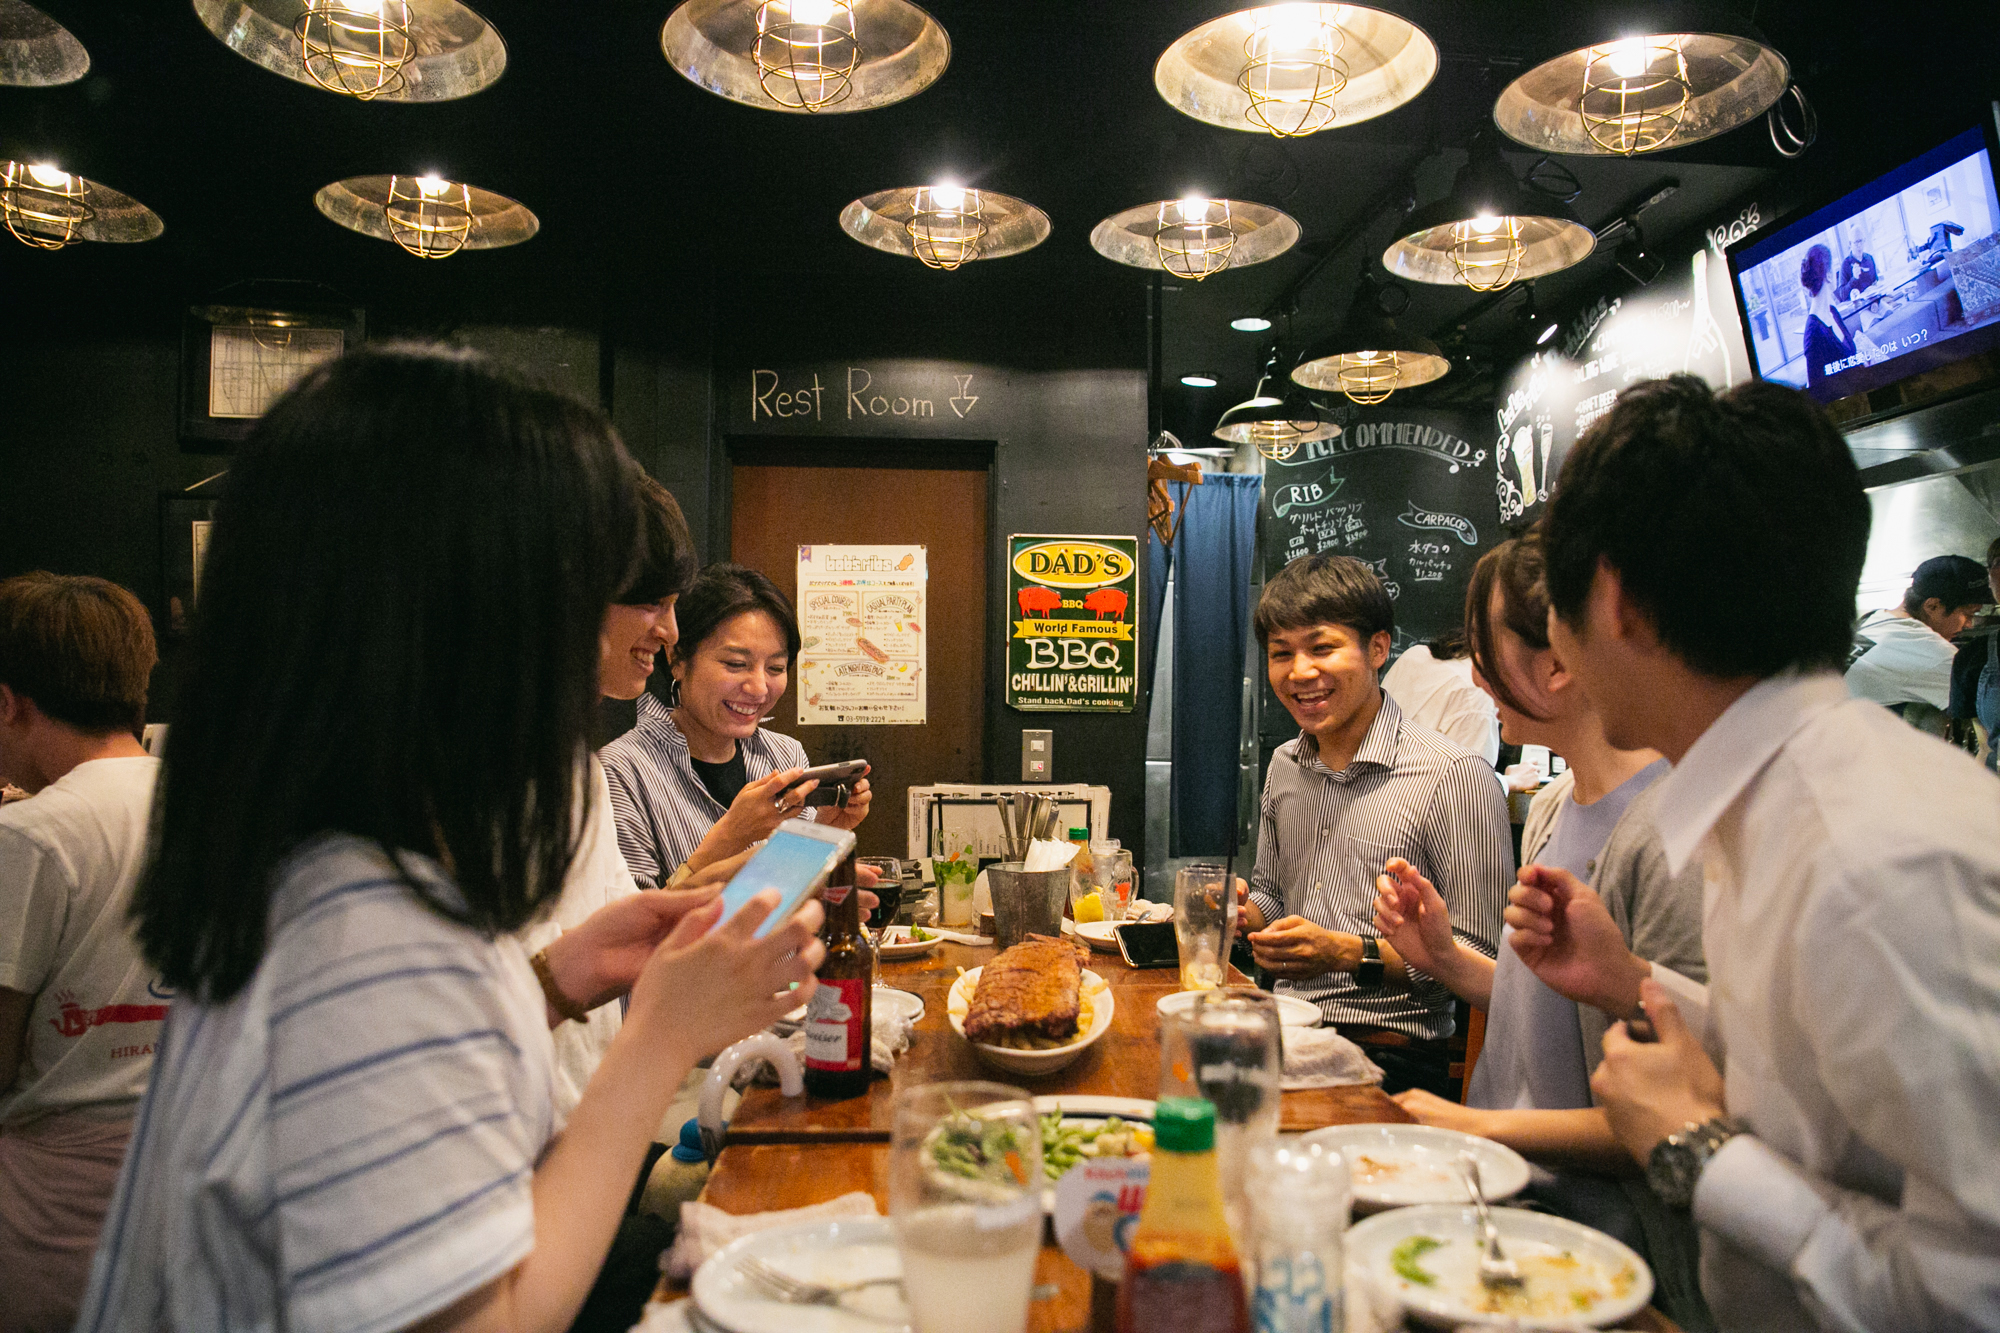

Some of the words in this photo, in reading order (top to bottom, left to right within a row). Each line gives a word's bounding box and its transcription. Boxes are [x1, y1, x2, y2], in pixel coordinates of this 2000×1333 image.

[1824, 340, 1898, 375] 最後に恋愛したのは
[752, 369, 825, 422] Rest
[847, 367, 934, 420] Room
[1289, 484, 1323, 502] RIB
[862, 555, 892, 571] ribs
[1029, 552, 1124, 577] DAD'S
[809, 595, 831, 611] SPECIAL
[831, 595, 854, 609] COURSE
[866, 598, 886, 614] CASUAL
[1061, 599, 1084, 609] BBQ
[1034, 622, 1068, 633] World
[1071, 623, 1118, 634] Famous
[1024, 638, 1123, 674] BBQ
[1018, 696, 1042, 705] Stand
[1092, 698, 1124, 707] cooking
[806, 1028, 842, 1043] weiser
